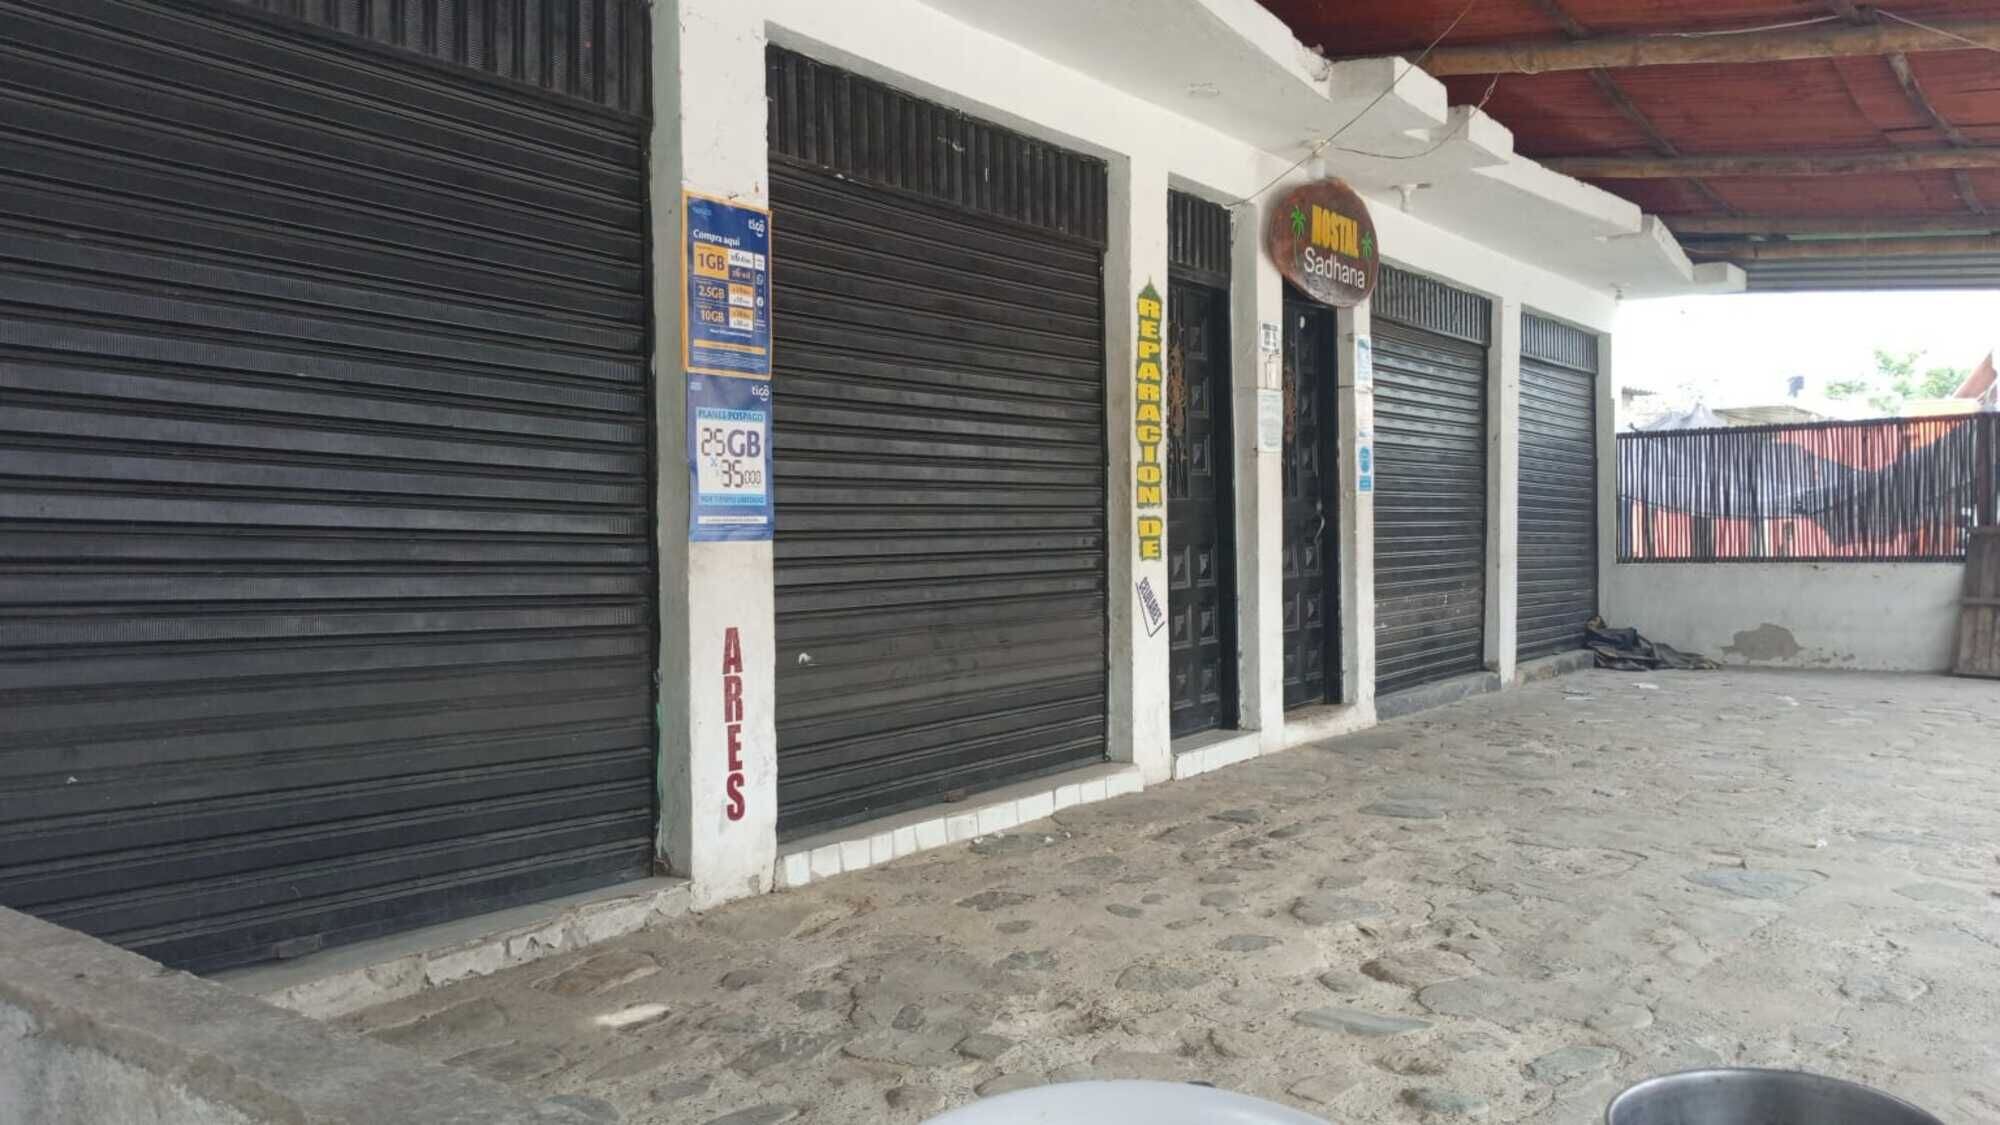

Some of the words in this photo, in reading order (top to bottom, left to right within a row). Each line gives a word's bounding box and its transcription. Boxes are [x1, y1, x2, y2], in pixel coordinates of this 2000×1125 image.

[693, 229, 722, 244] Compra
[698, 252, 725, 271] 1GB
[1303, 247, 1365, 289] Sadhana
[700, 309, 725, 324] 10GB
[1136, 297, 1163, 507] REPARACION
[1137, 517, 1163, 561] DE
[722, 627, 746, 821] ARES
